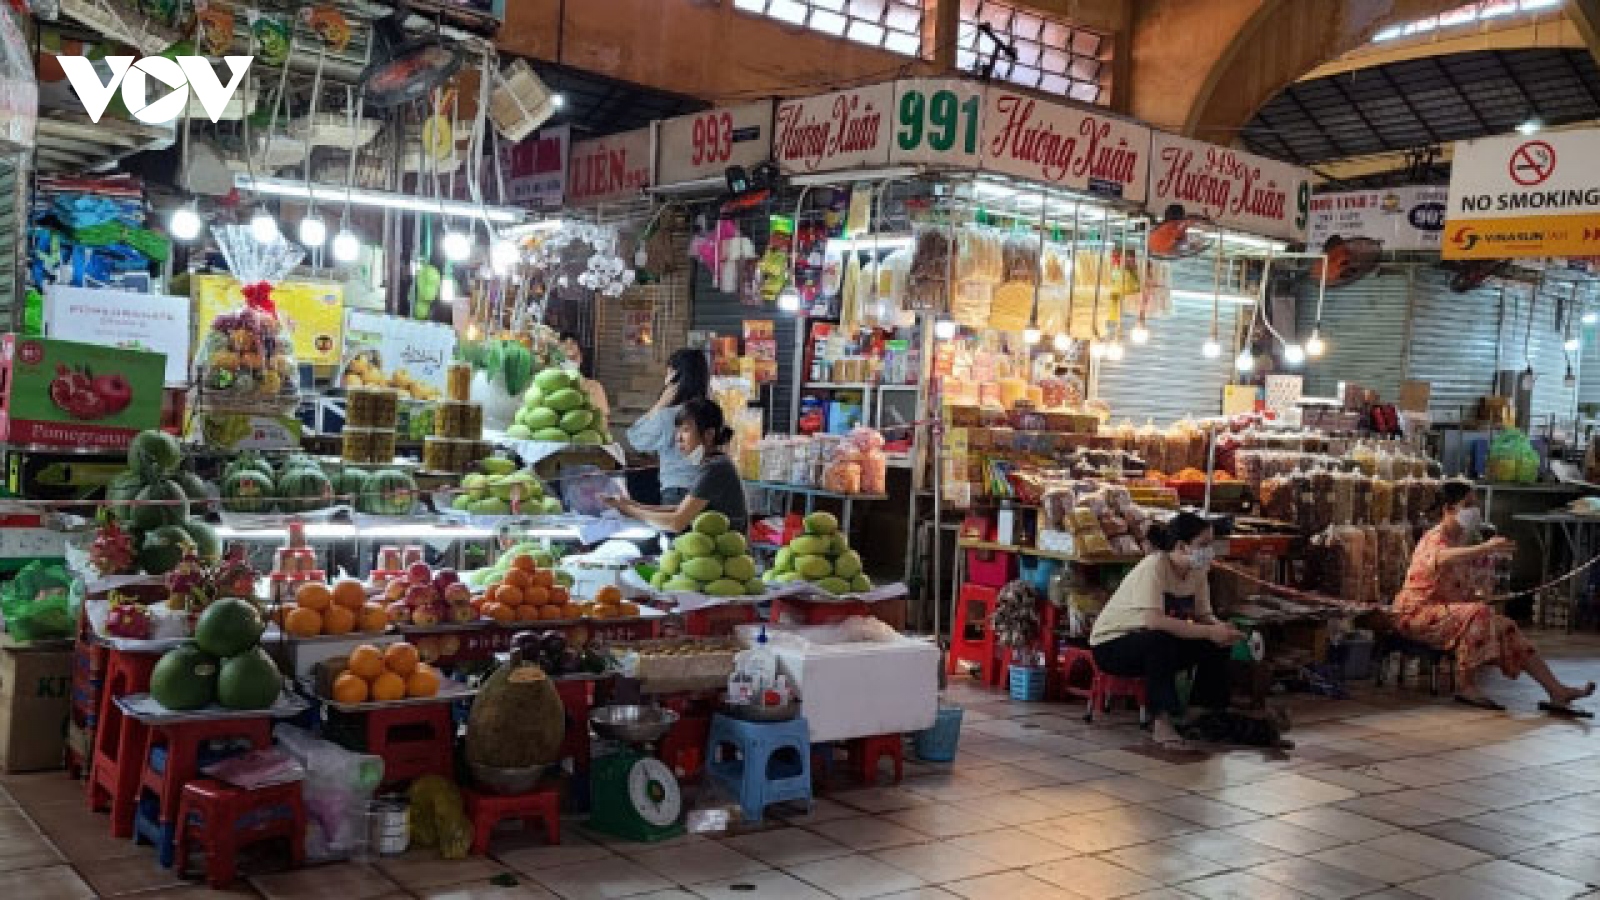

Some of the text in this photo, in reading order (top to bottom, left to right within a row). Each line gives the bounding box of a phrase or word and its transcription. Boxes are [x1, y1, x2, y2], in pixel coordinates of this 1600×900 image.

[692, 112, 733, 166] 993
[897, 90, 981, 155] 991
[1074, 116, 1139, 184] Xuân
[1461, 194, 1492, 212] NO
[1497, 188, 1600, 210] SMOKING
[32, 424, 131, 444] Pomegranat
